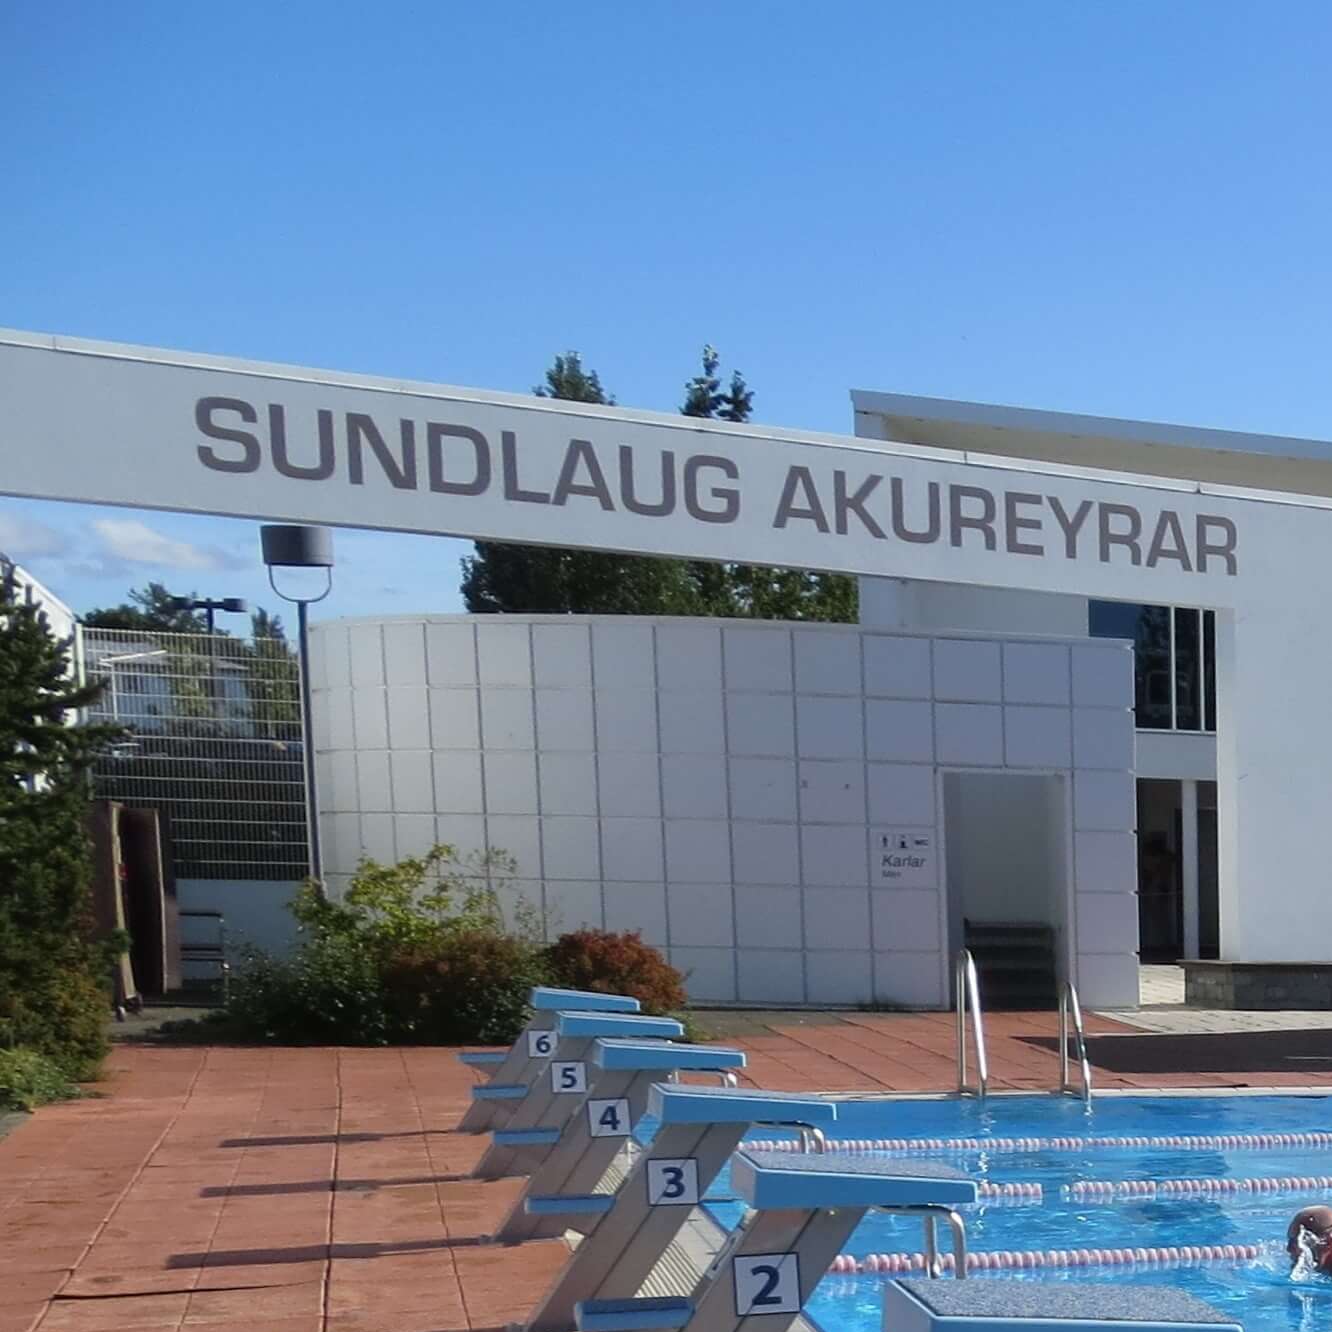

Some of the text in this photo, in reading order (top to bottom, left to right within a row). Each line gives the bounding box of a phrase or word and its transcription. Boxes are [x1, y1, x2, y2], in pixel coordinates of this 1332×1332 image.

[194, 395, 1239, 577] SUNDLAUG AKUREYRAR
[536, 1035, 551, 1053] 6
[561, 1067, 577, 1089] 5
[599, 1105, 620, 1131] 4
[662, 1166, 685, 1198] 3
[751, 1265, 782, 1306] 2
